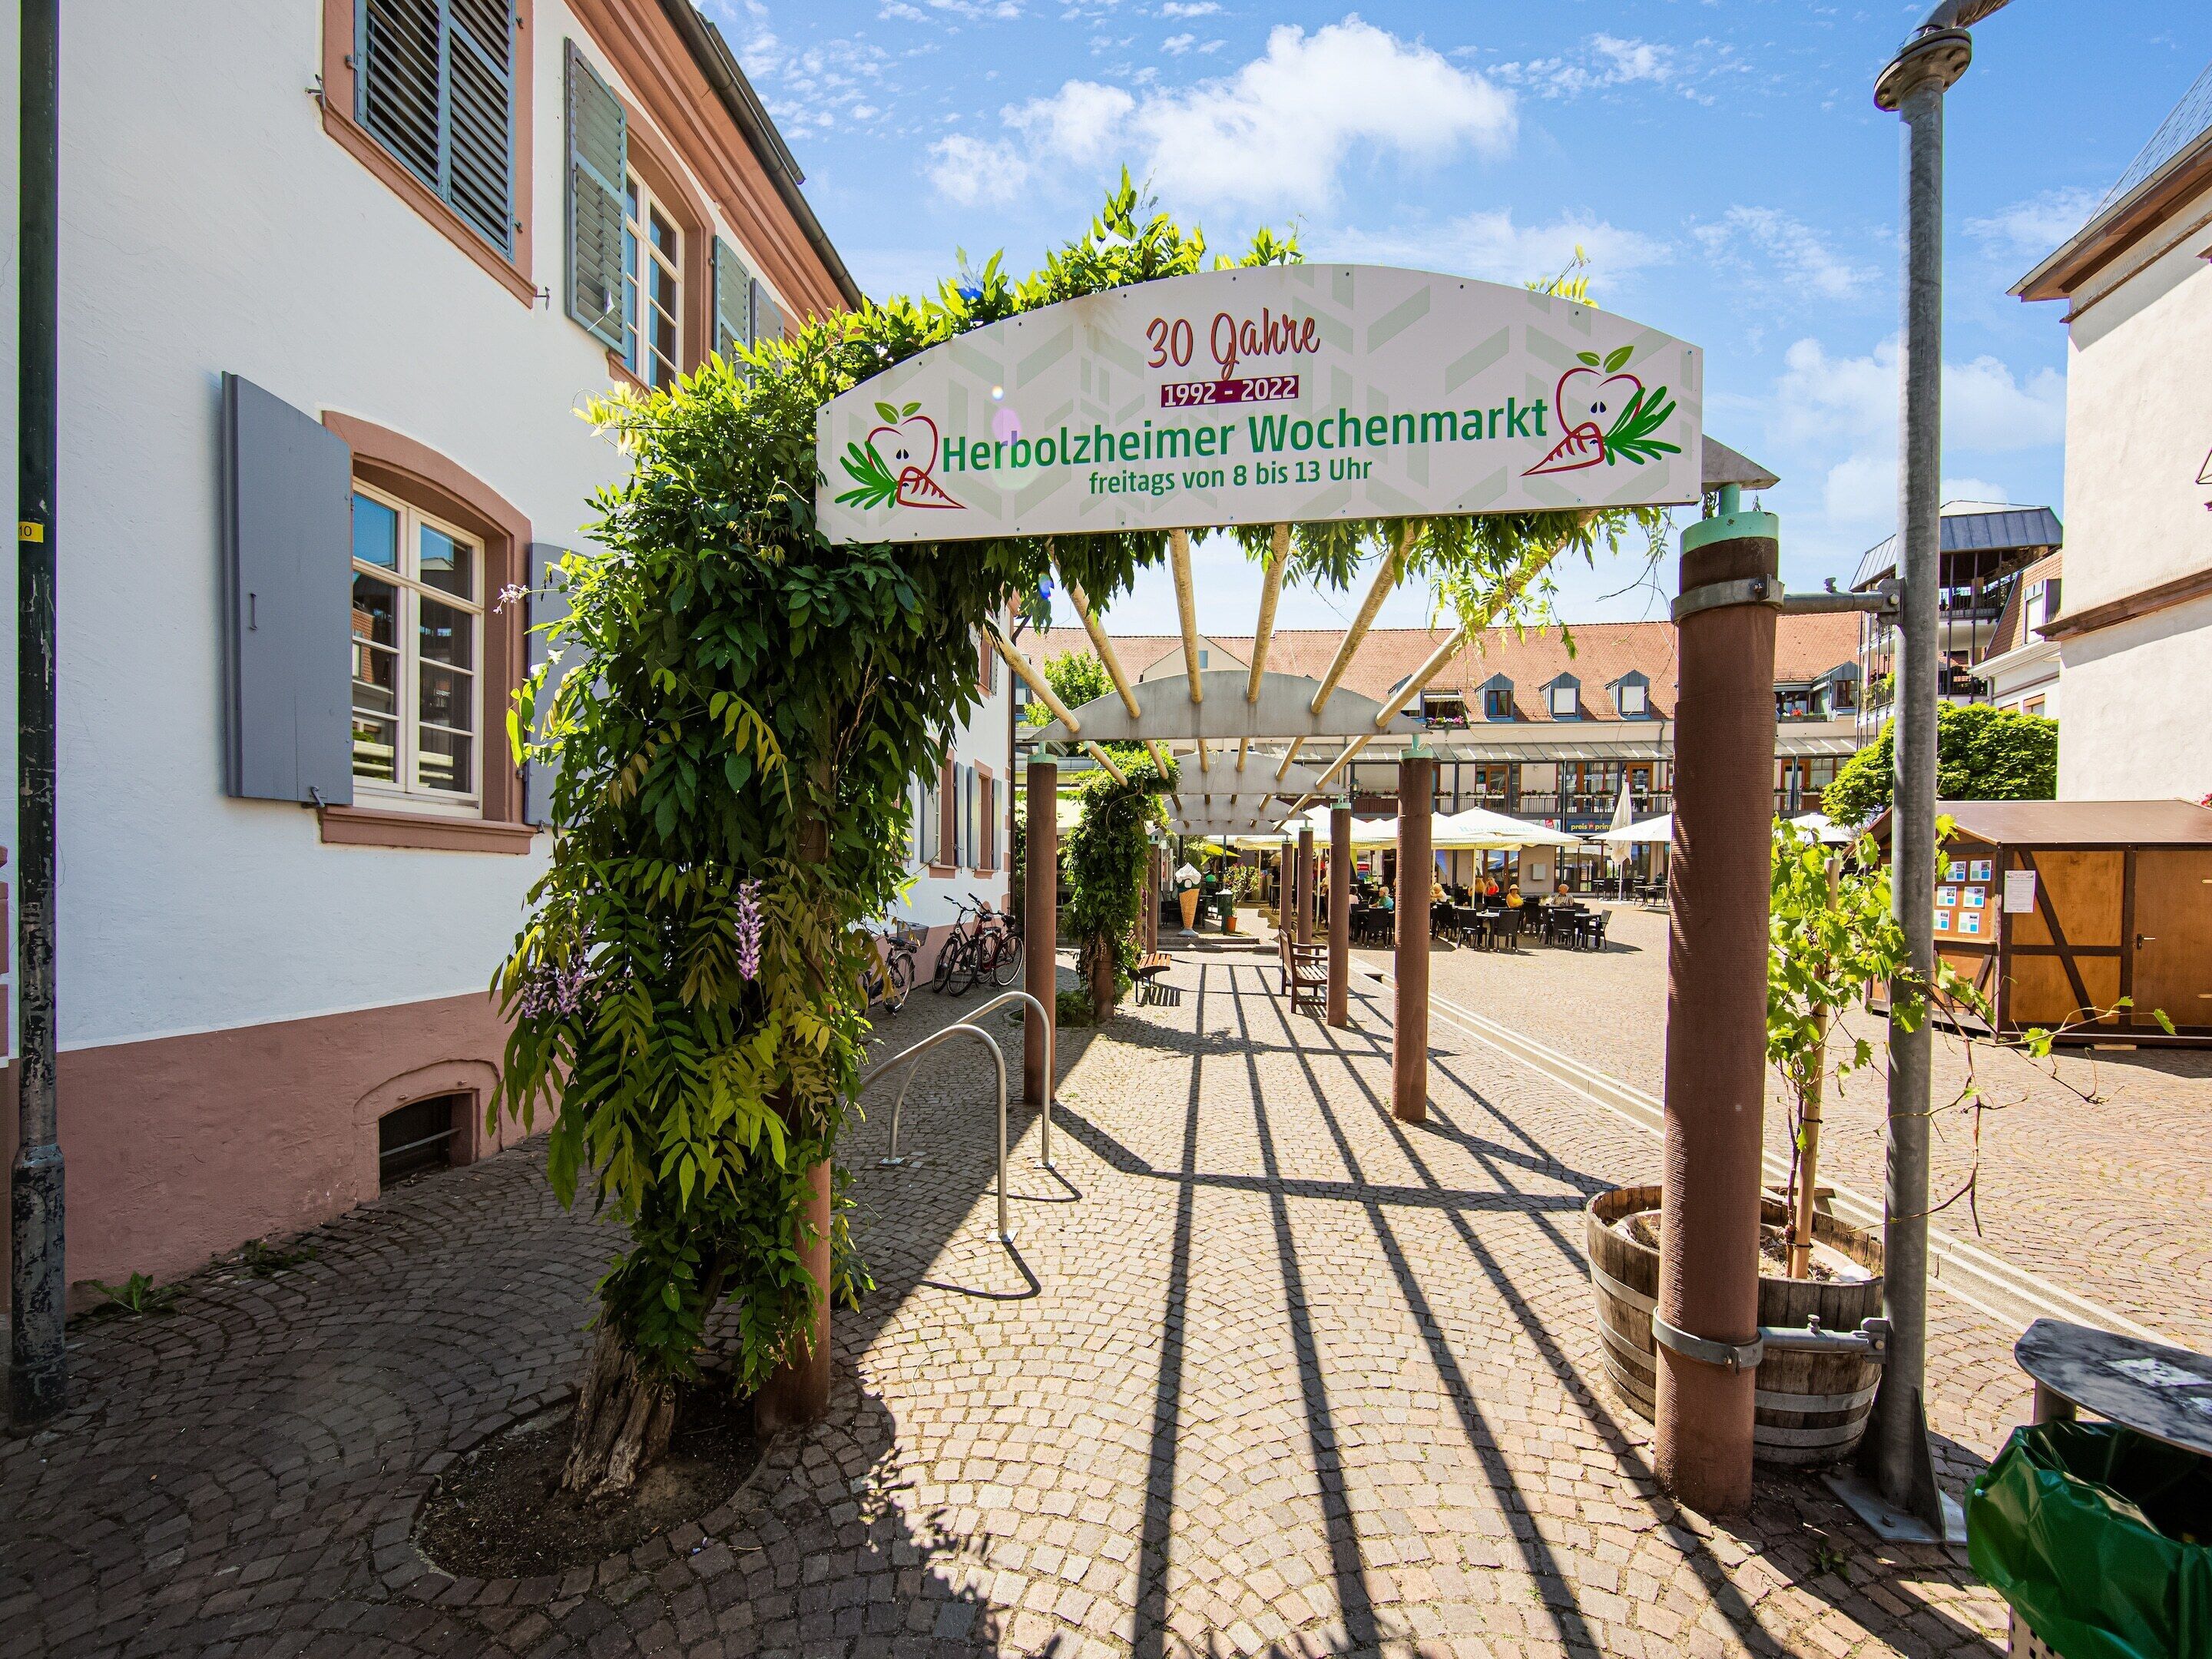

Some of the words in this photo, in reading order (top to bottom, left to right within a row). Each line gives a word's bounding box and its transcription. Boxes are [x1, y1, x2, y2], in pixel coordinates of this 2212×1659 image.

[1146, 317, 1194, 368] 30
[1210, 307, 1320, 381] Jahre
[1164, 382, 1216, 406] 1992
[1241, 376, 1296, 402] 2022
[942, 420, 1236, 472] Herbolzheimer
[1248, 397, 1548, 453] Wochenmarkt
[1089, 470, 1175, 496] freitags
[1182, 470, 1224, 488] von
[1233, 465, 1247, 486] 8
[1256, 461, 1288, 485] bis
[1294, 461, 1320, 483] 13
[1330, 457, 1373, 481] Uhr
[1571, 823, 1588, 832] preis
